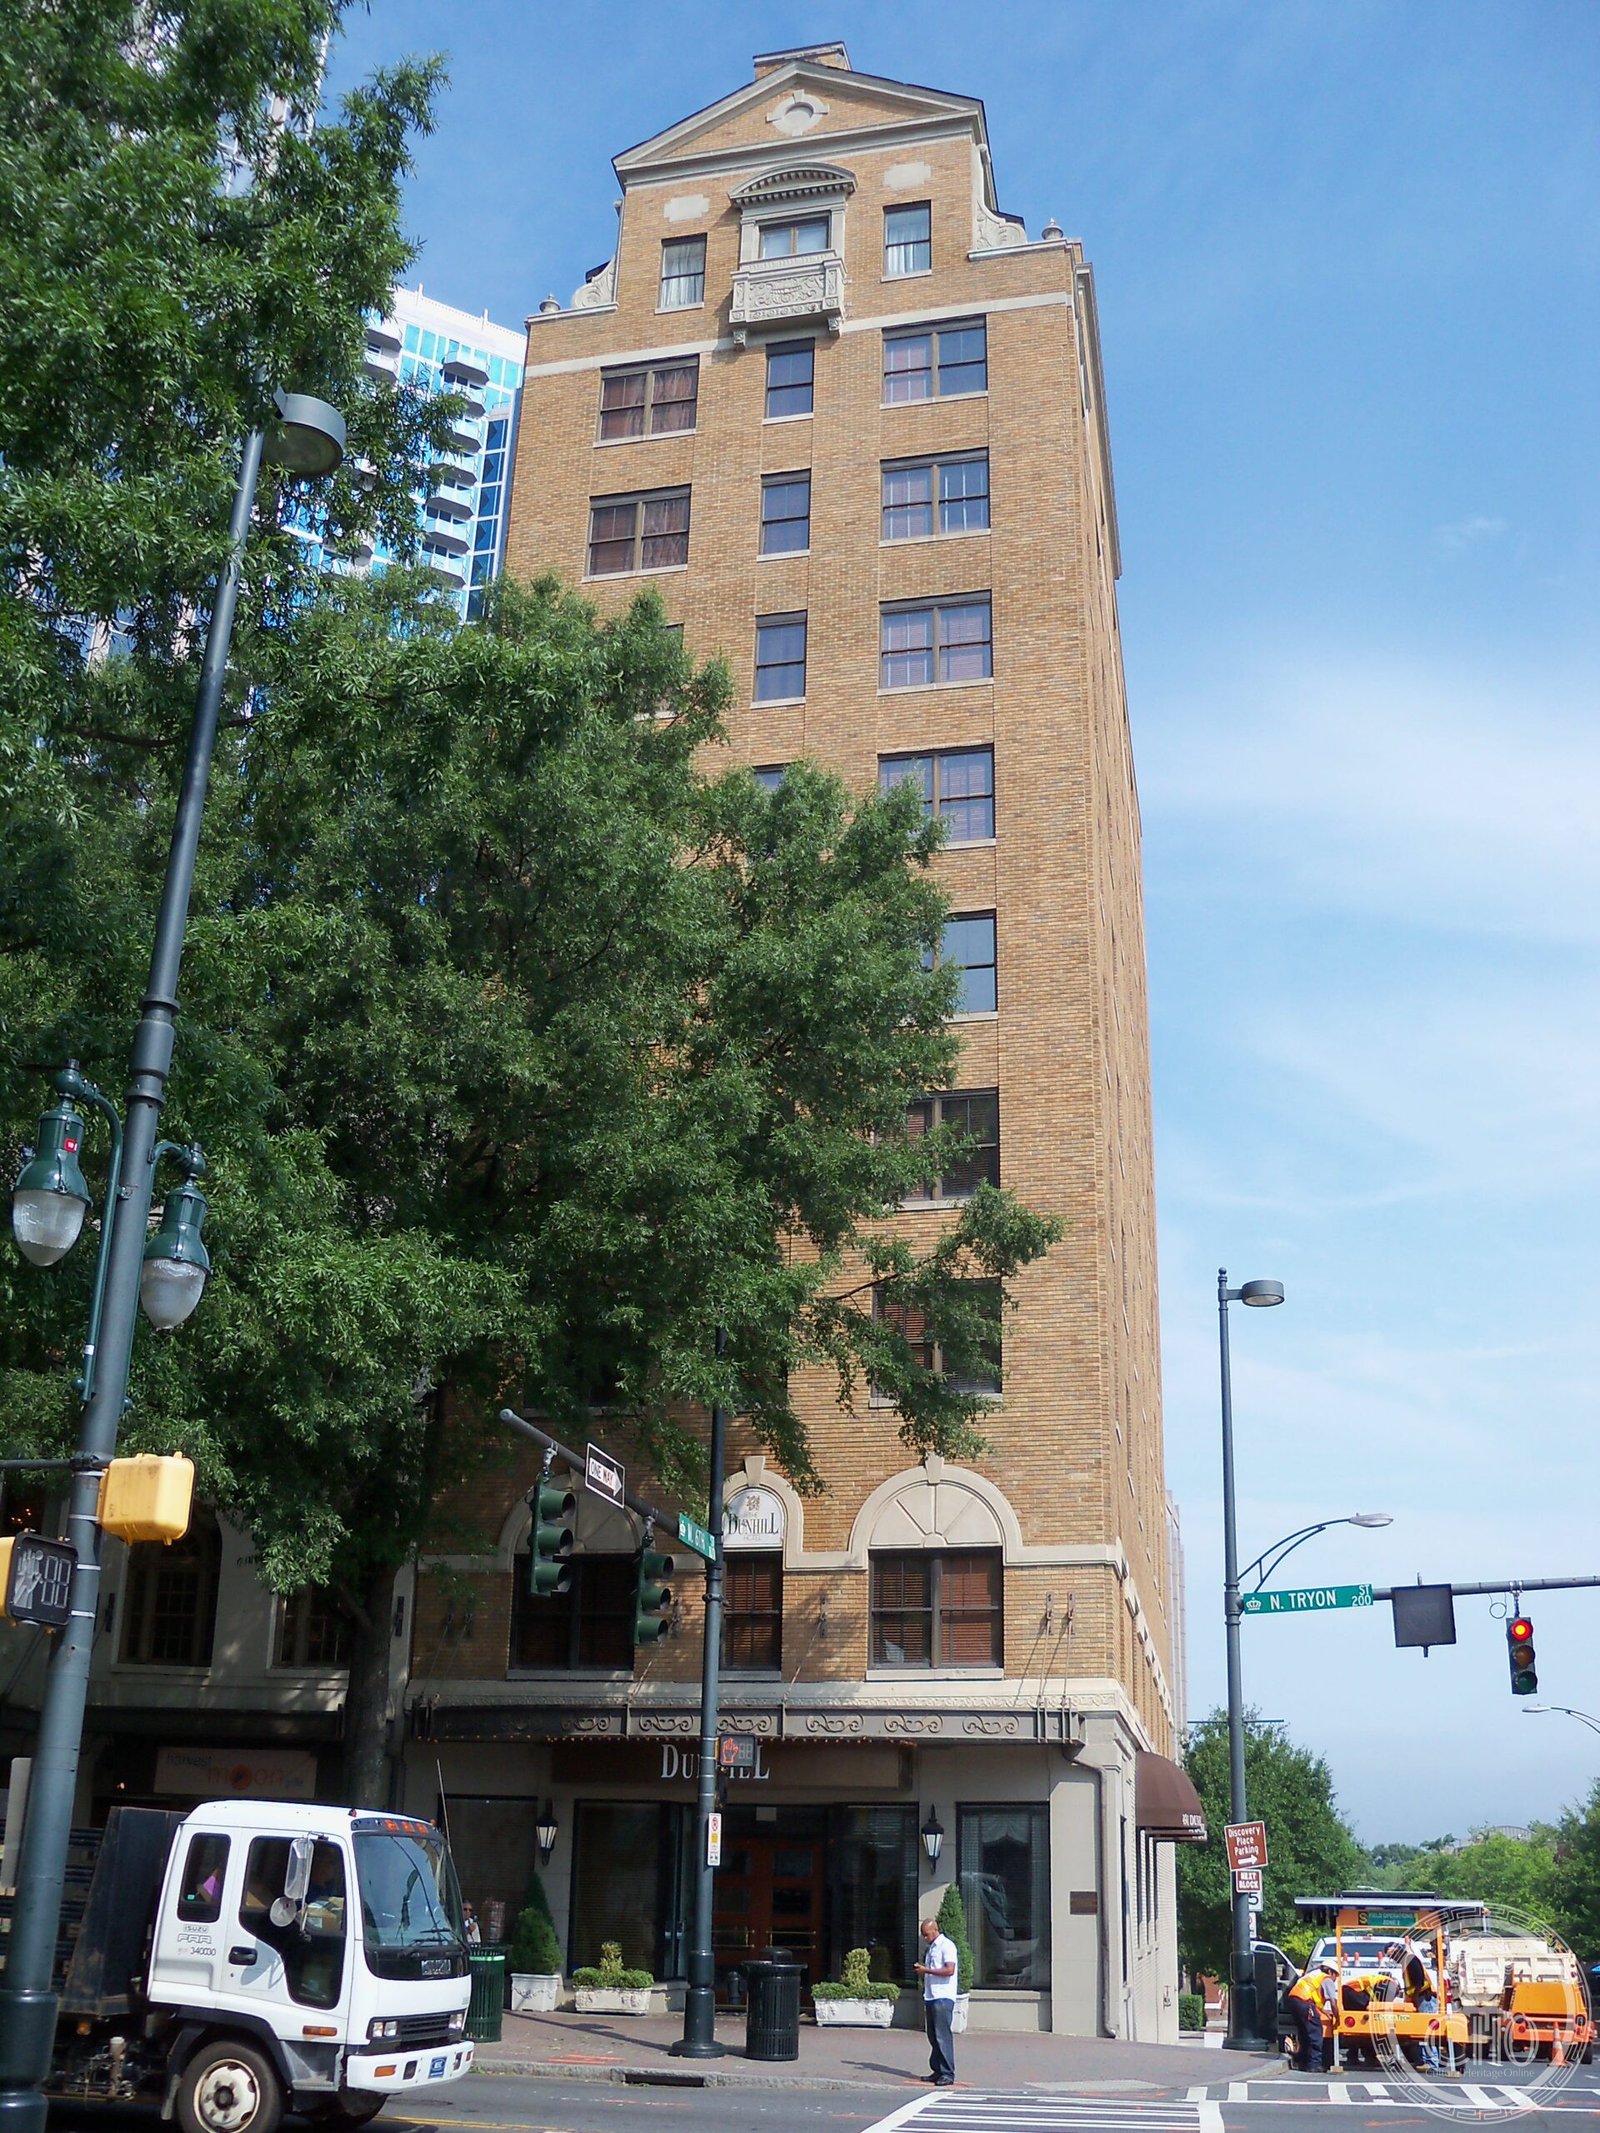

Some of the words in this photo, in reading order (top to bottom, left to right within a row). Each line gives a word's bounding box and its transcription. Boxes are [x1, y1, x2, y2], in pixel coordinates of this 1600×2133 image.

[728, 1512, 779, 1535] DUNHILL
[1270, 1594, 1285, 1610] N.
[1288, 1590, 1337, 1608] TRYON
[1359, 1583, 1371, 1596] ST
[1351, 1594, 1372, 1607] 200
[1228, 1825, 1261, 1838] Discovery
[1236, 1836, 1254, 1846] Place
[1234, 1845, 1259, 1857] Parking
[1240, 1872, 1257, 1880] NEXT
[1238, 1880, 1259, 1889] BLOCK
